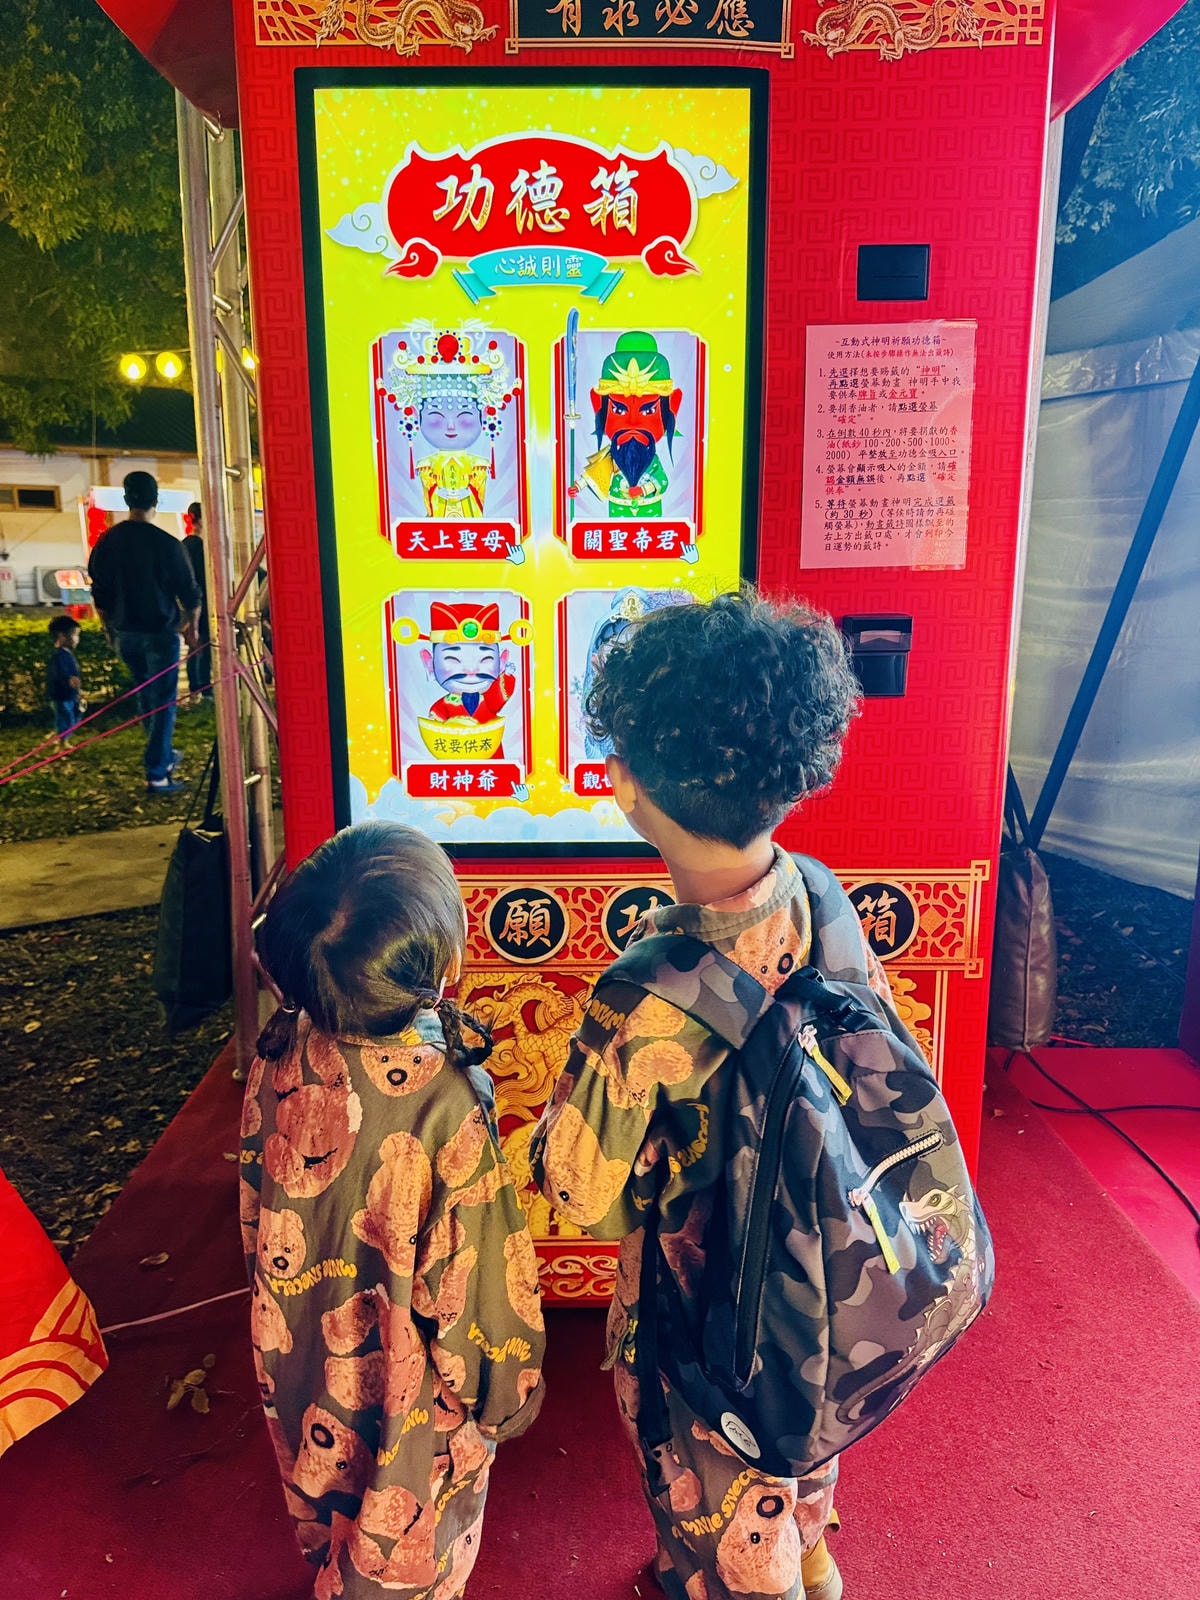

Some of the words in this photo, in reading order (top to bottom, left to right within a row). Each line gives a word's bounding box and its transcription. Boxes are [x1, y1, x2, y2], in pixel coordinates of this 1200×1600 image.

[433, 160, 639, 236] 功德箱
[495, 255, 584, 278] 心誠則靈
[408, 529, 505, 551] 天上聖母
[584, 527, 678, 551] 關聖帝君
[433, 737, 493, 753] 我要供奉
[429, 770, 499, 792] 財神爺
[499, 897, 553, 946] 願
